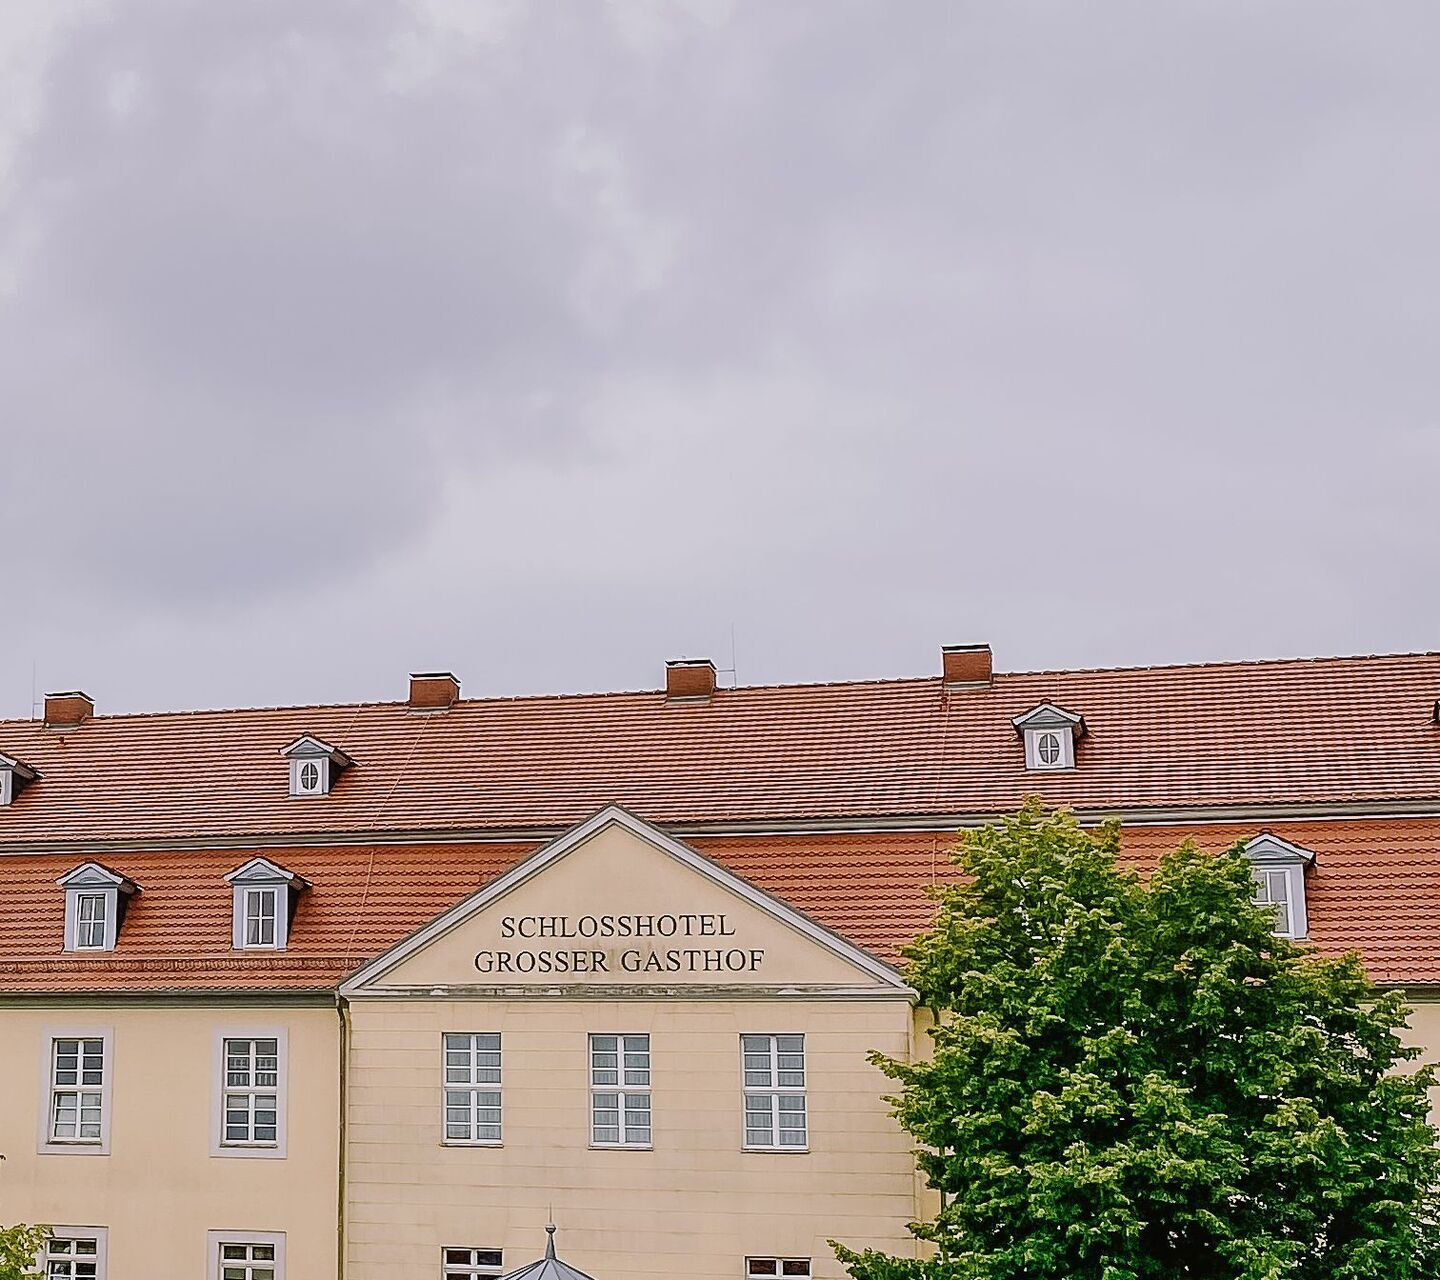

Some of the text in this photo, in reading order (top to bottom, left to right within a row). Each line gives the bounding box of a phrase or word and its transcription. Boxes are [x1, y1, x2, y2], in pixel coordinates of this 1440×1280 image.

[501, 914, 736, 939] SCHLOSSHOTEL
[474, 949, 765, 973] GROSSER GASTHOF
